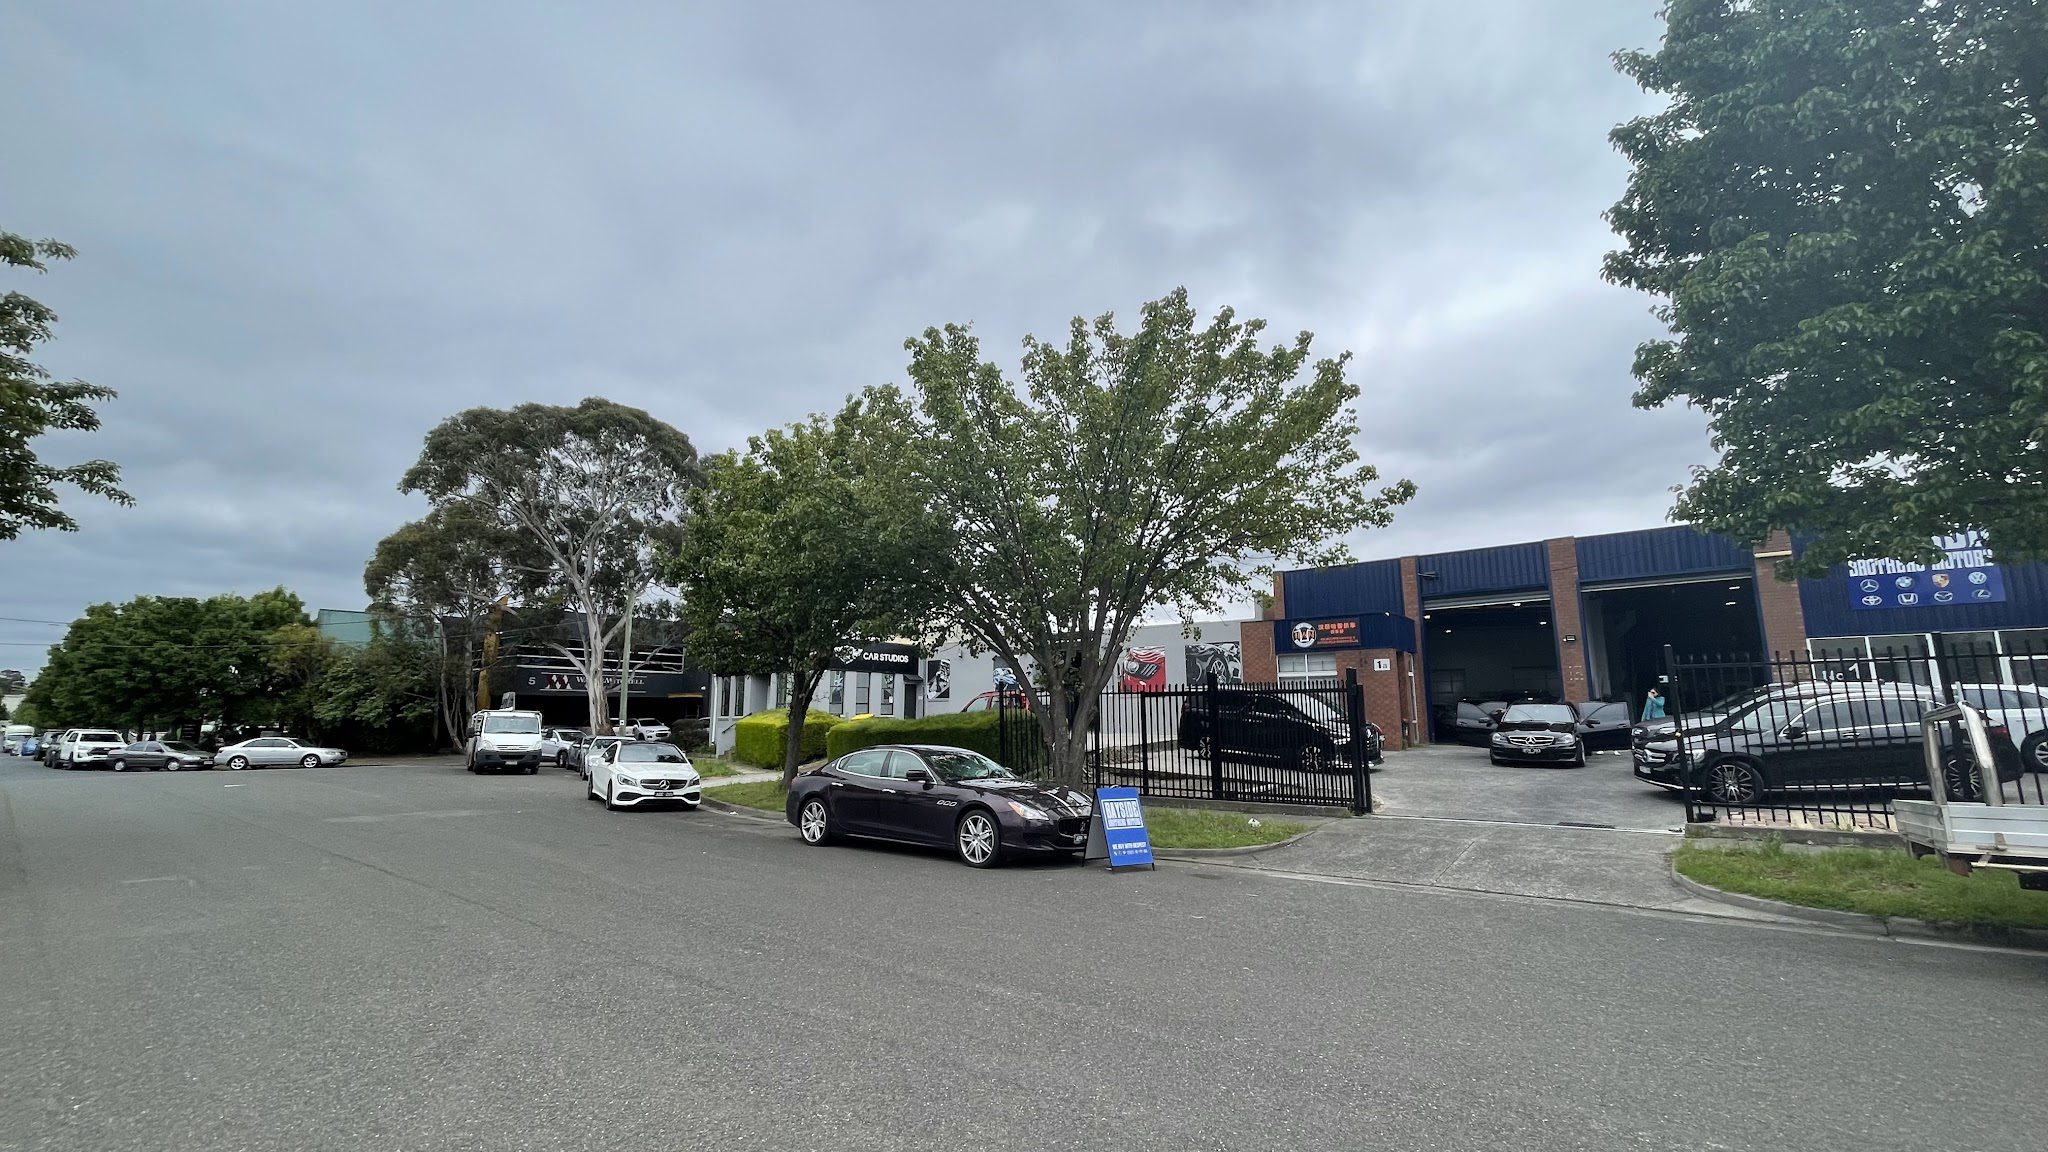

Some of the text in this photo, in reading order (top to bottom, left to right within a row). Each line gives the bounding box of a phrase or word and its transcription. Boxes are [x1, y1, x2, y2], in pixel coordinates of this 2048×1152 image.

[863, 652, 909, 663] CAR STUDIOS
[528, 677, 536, 685] 5
[1104, 801, 1140, 818] BAYSIDE
